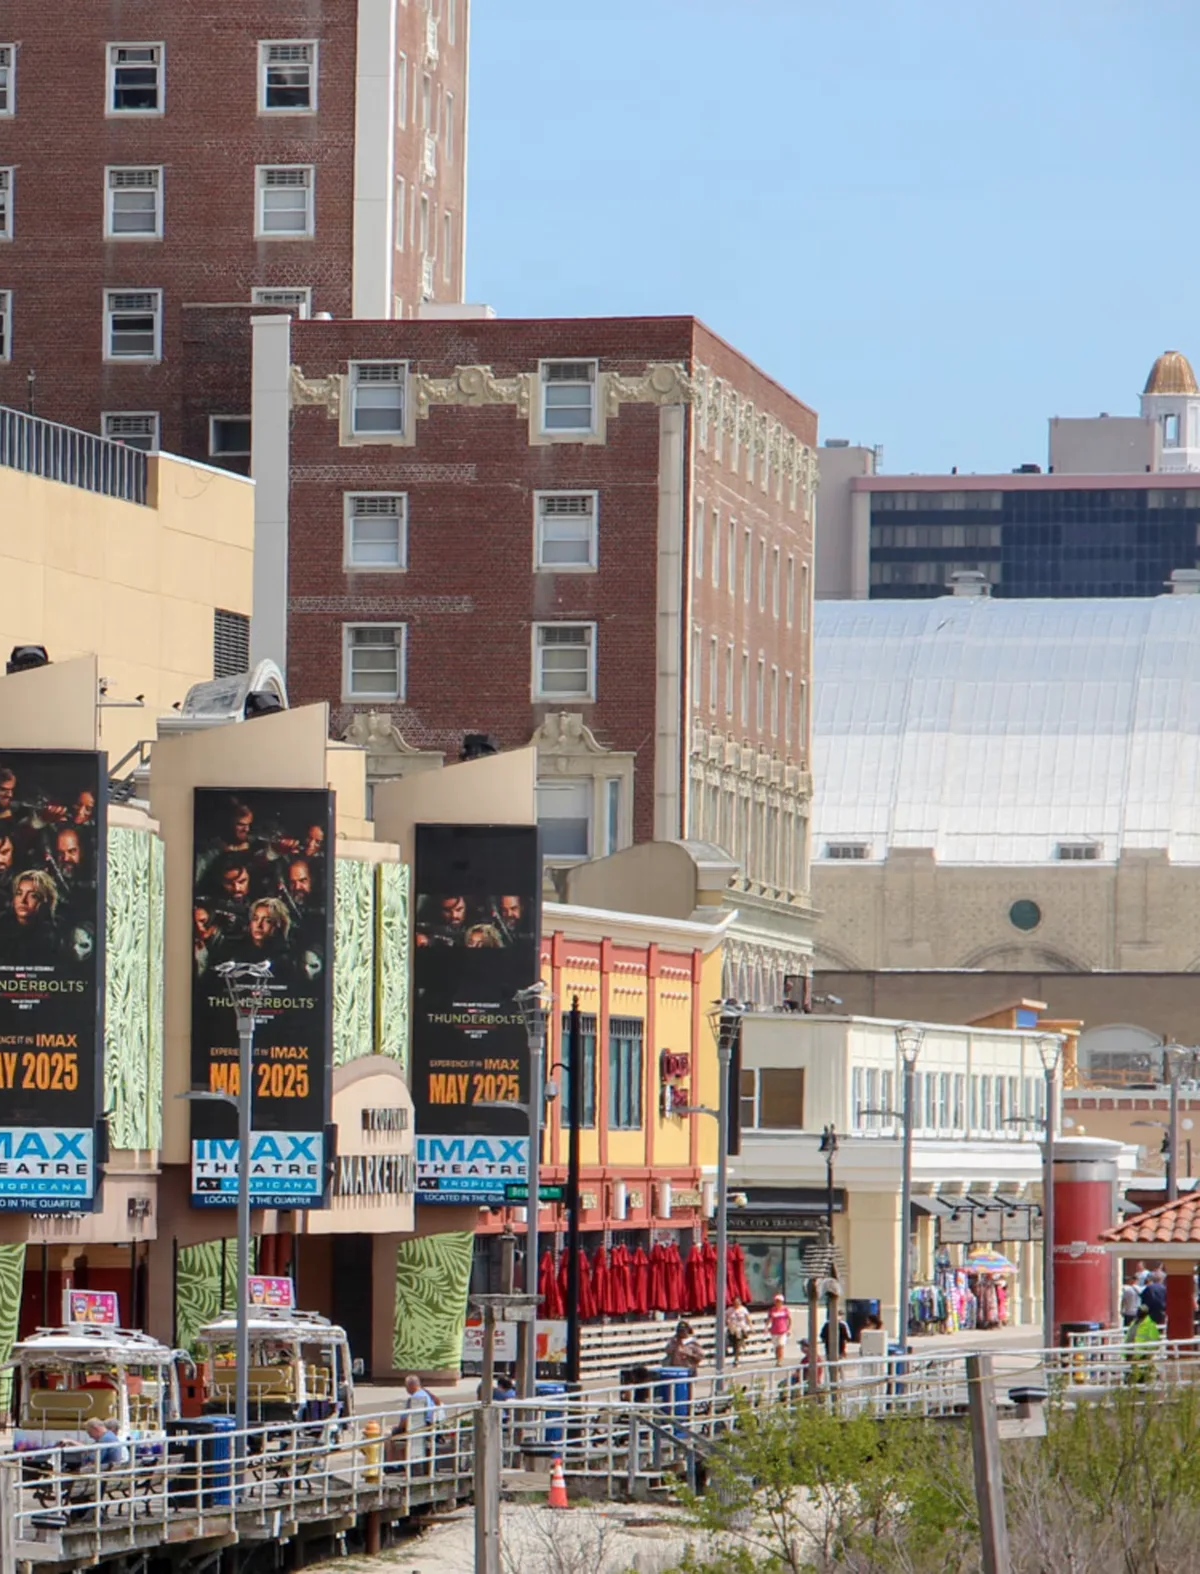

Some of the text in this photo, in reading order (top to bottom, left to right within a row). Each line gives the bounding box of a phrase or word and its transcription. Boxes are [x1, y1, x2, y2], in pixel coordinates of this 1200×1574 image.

[36, 1033, 78, 1048] IMAX
[270, 1046, 309, 1059] IMAX
[21, 1051, 78, 1091] 2025
[484, 1058, 520, 1071] IMAX
[210, 1062, 309, 1098] MA 2025
[429, 1073, 520, 1105] MAY 2025
[196, 1135, 317, 1161] IMAX
[416, 1138, 526, 1162] IMAX
[417, 1164, 527, 1175] THEATRE
[420, 1180, 503, 1189] AT TROPICA
[8, 1199, 19, 1208] IN
[20, 1199, 37, 1208] THE
[39, 1199, 81, 1209] QUARTER
[204, 1196, 240, 1204] LOCATE
[256, 1197, 273, 1205] THE
[273, 1197, 312, 1205] QUARTER
[424, 1193, 460, 1201] LOCATED
[471, 1194, 487, 1202] THE
